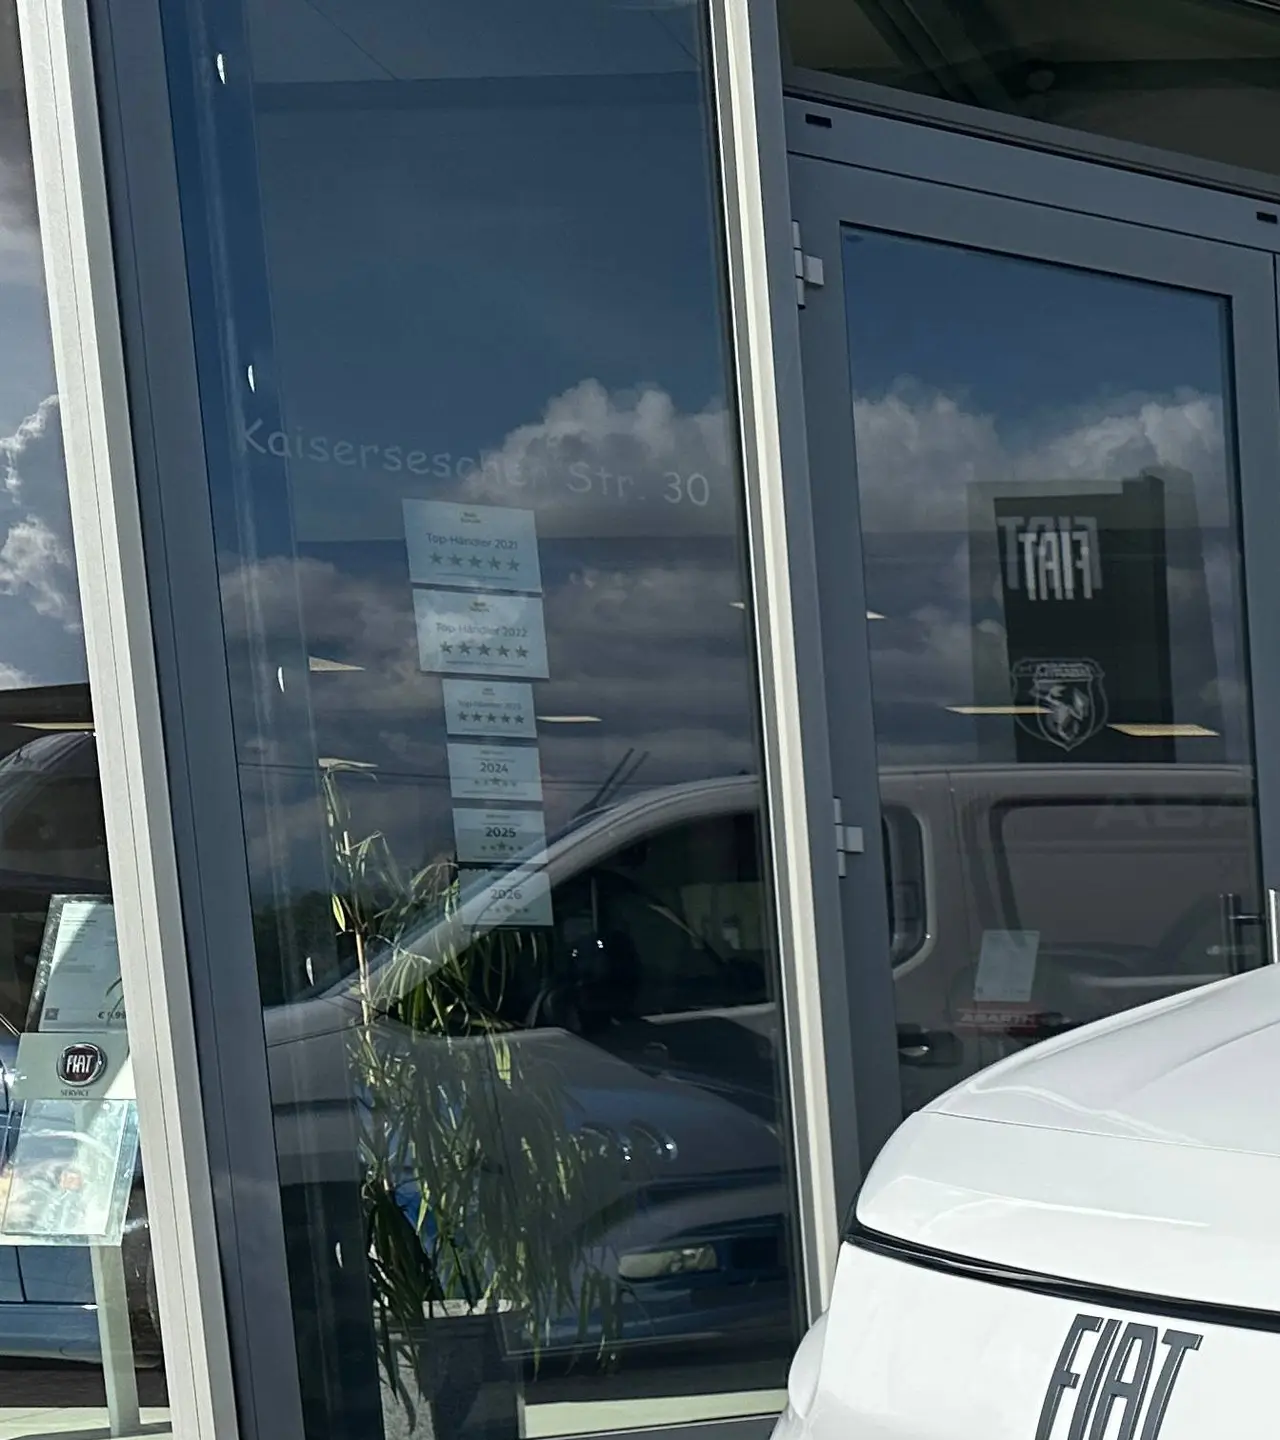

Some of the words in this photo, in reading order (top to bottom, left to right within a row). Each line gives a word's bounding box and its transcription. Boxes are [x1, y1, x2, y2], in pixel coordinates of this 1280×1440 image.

[566, 461, 645, 501] Str.
[663, 470, 710, 507] 30
[494, 538, 518, 549] 2021
[501, 625, 529, 638] 2022
[480, 761, 509, 774] 2024
[485, 825, 517, 839] 2025
[490, 888, 523, 901] 2026
[66, 1054, 94, 1074] FIAT
